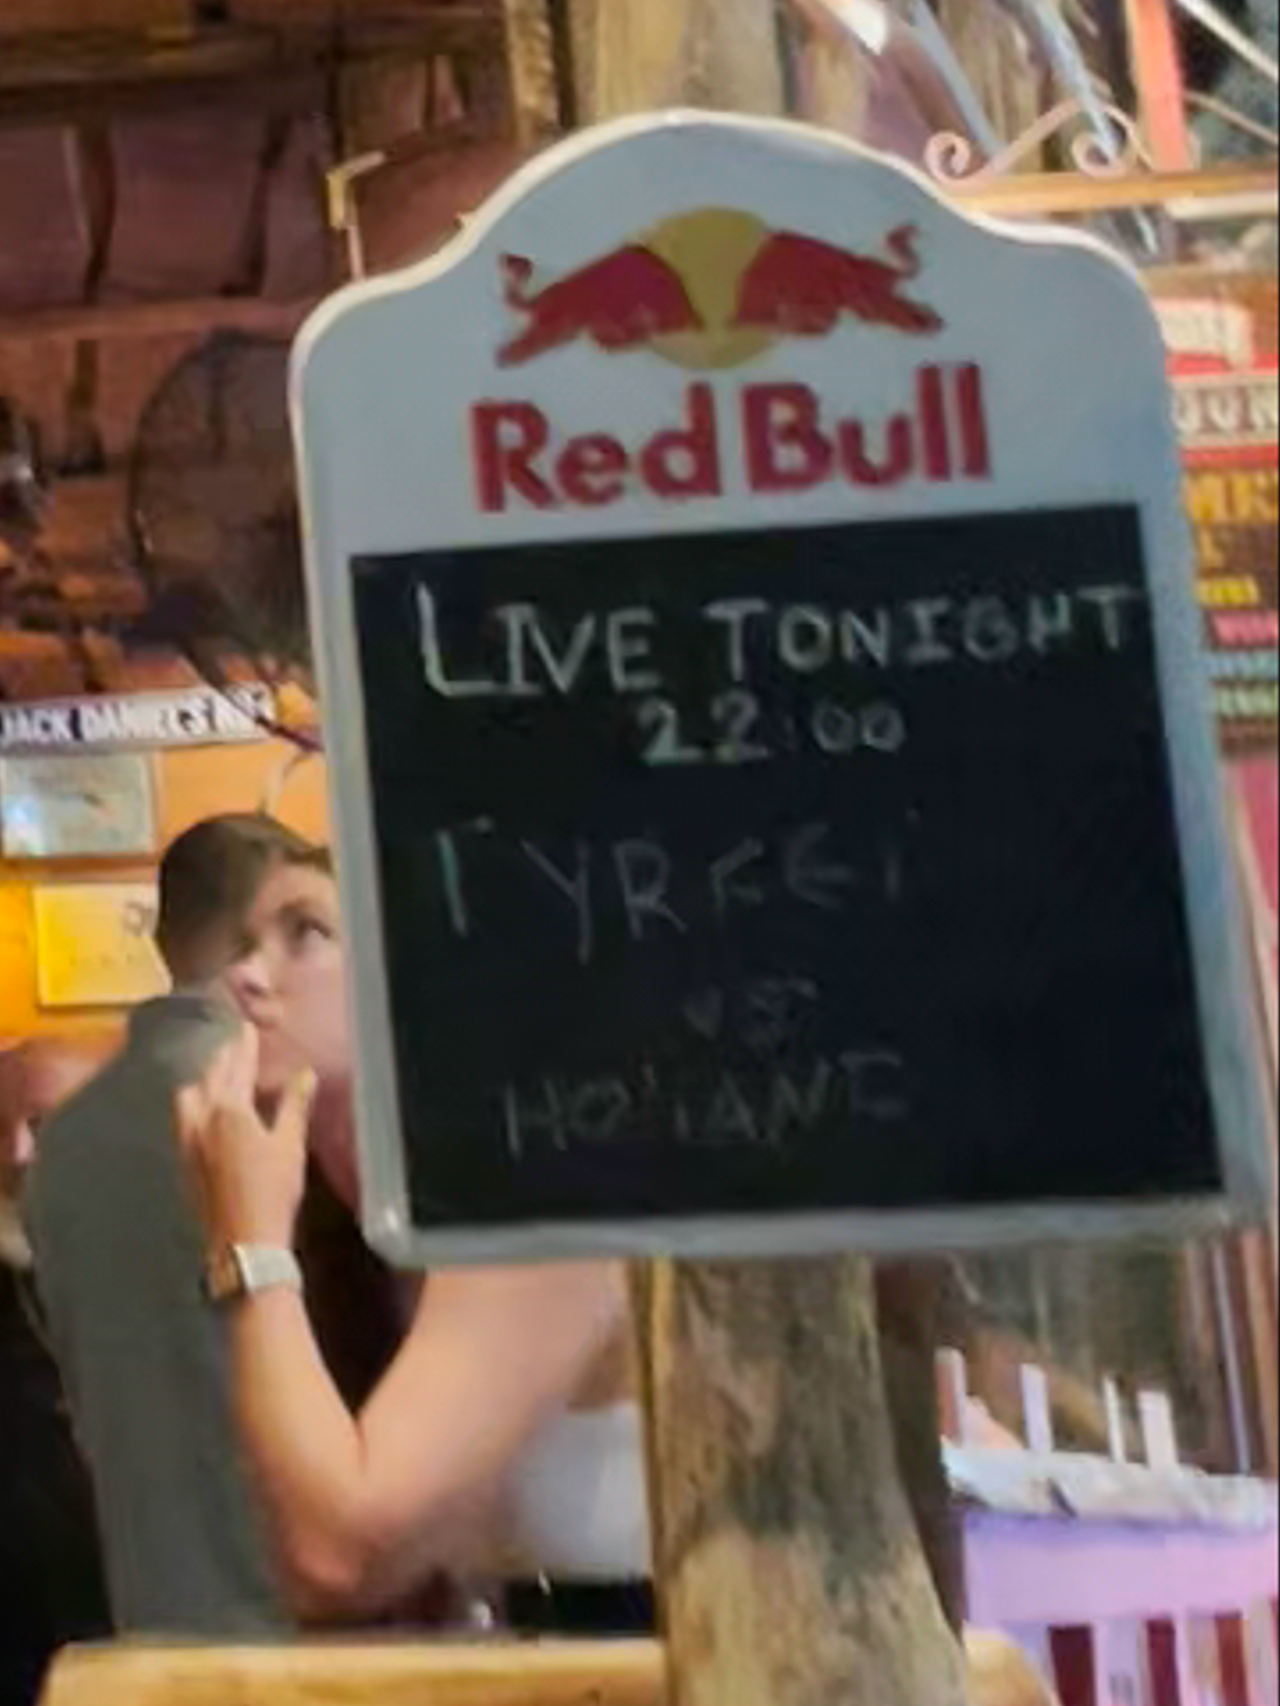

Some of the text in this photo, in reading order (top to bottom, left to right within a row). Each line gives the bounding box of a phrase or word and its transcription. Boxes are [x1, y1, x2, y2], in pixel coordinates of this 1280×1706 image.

[468, 361, 993, 513] Red Bull
[414, 581, 1140, 698] LIVE TONIGHT
